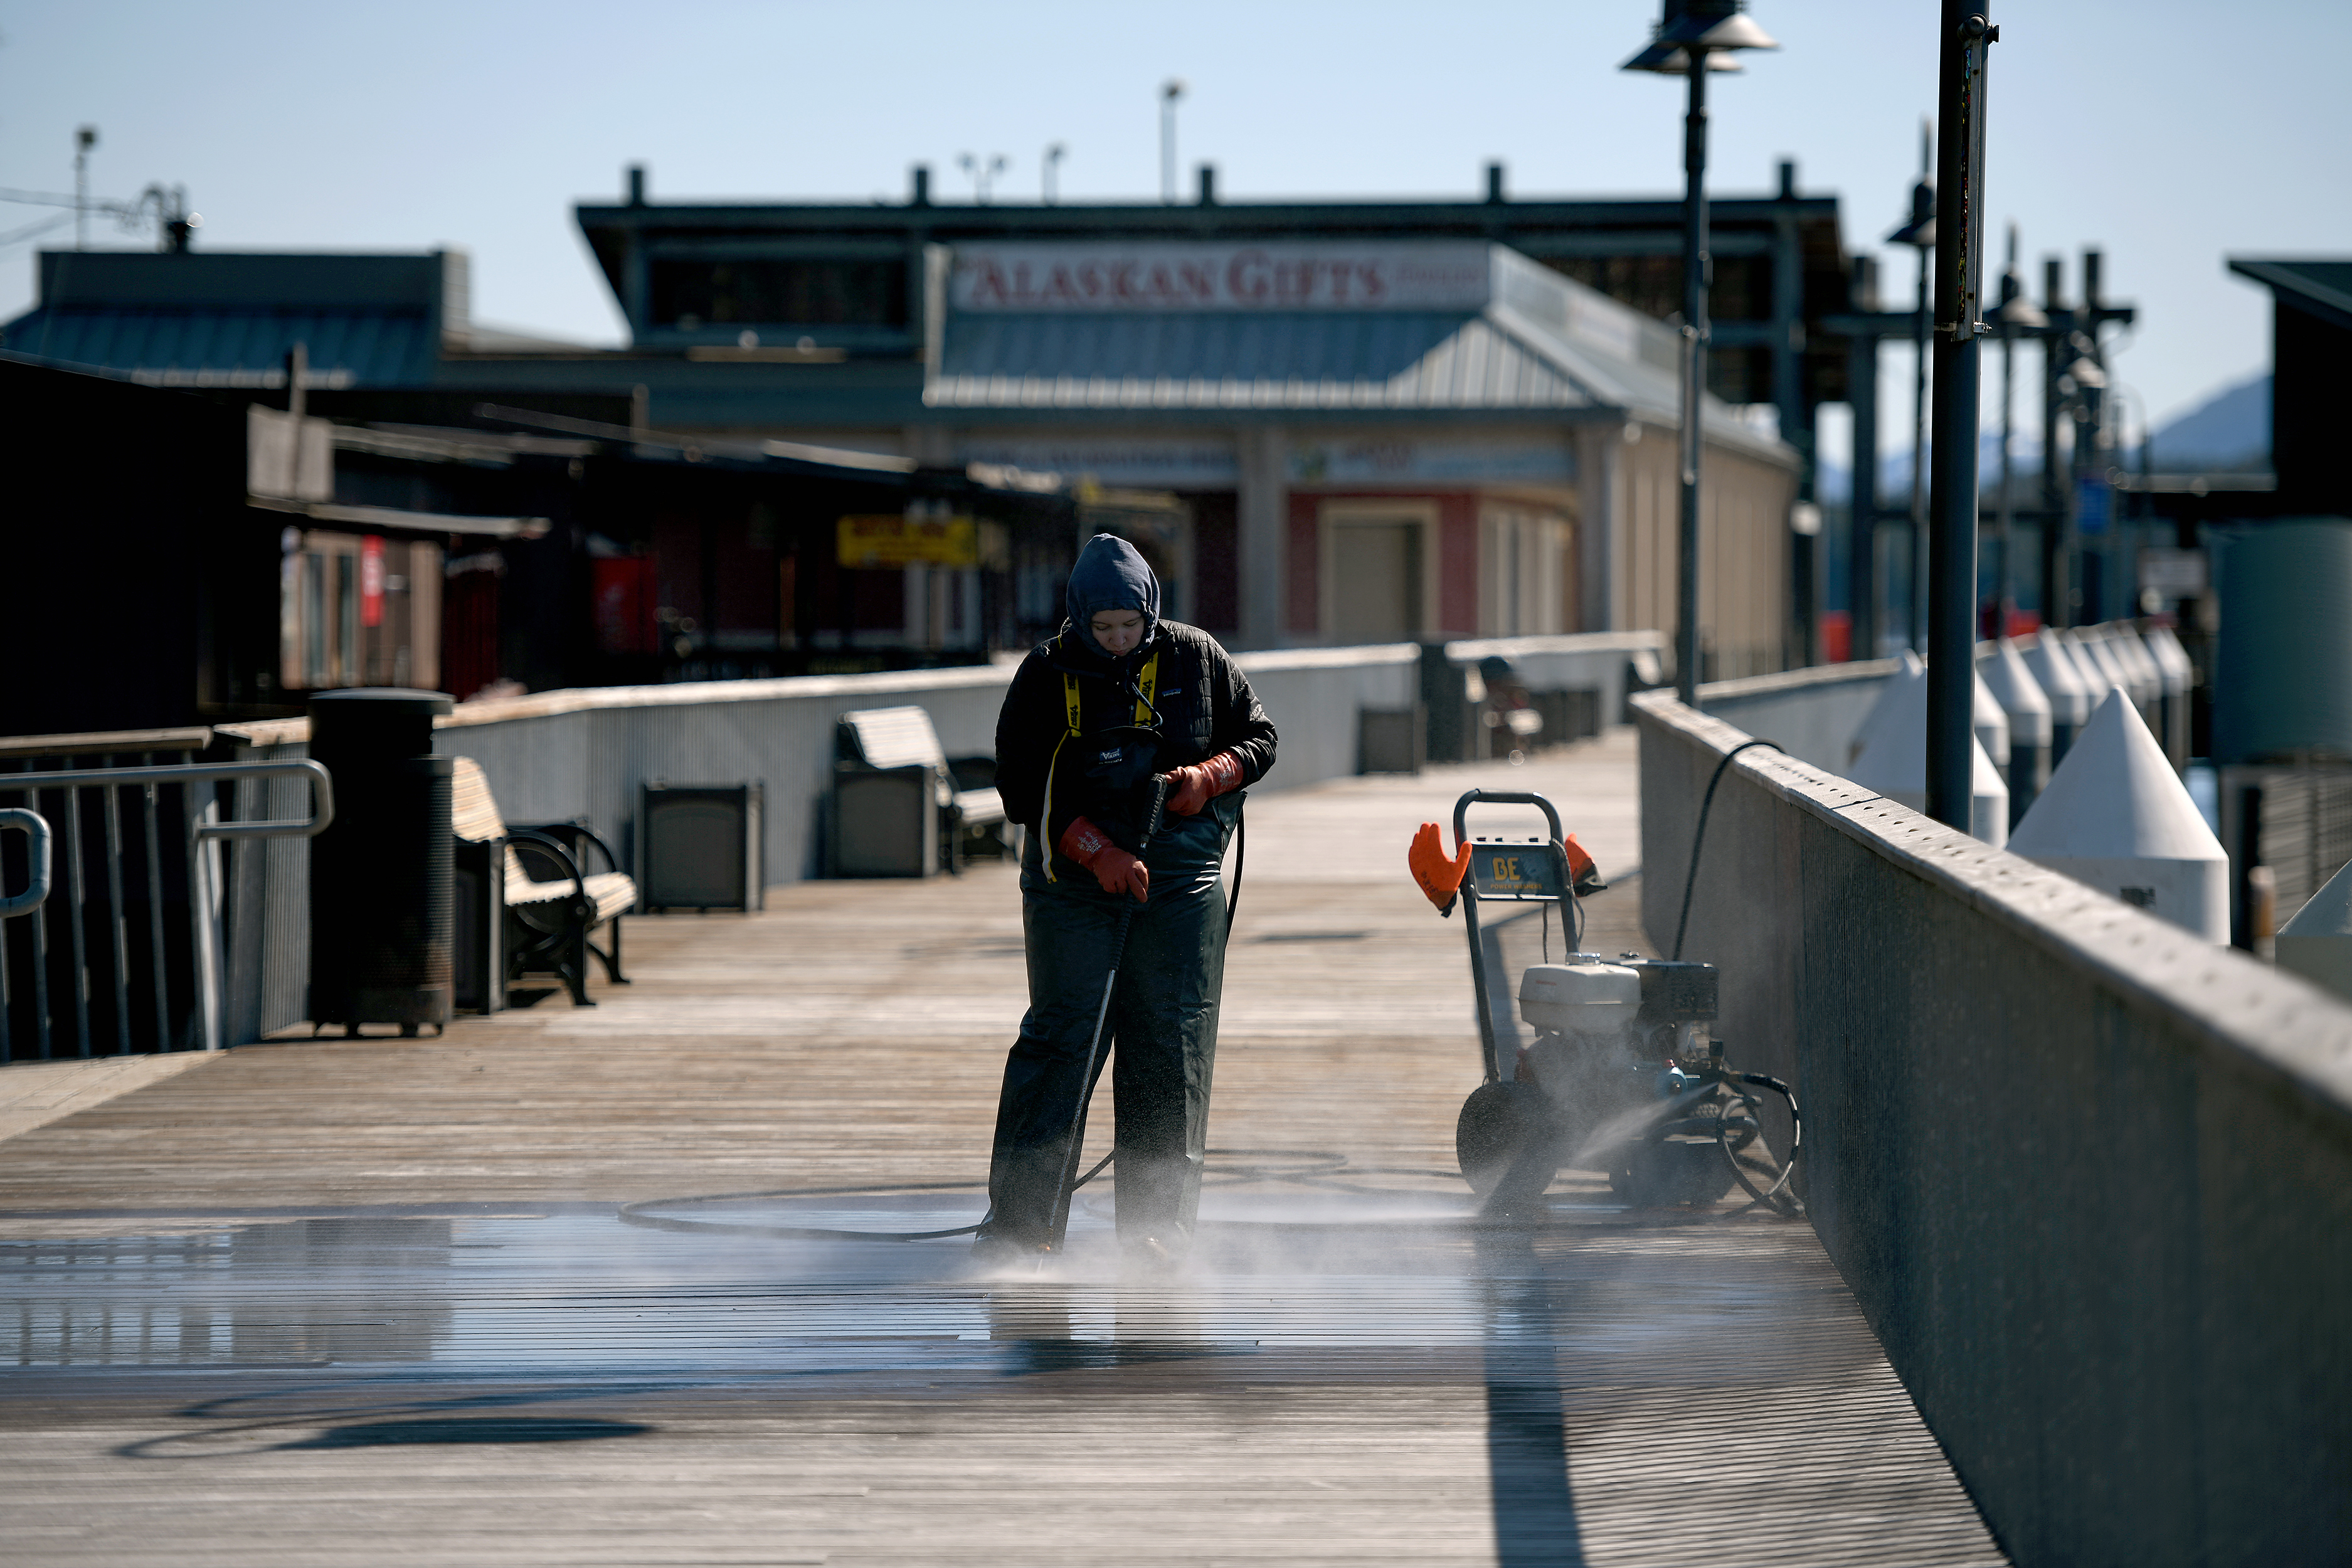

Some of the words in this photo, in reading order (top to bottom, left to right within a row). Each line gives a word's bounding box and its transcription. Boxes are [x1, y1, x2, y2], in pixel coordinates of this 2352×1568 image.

[971, 256, 1220, 305] ALASKAN
[1226, 250, 1388, 306] GIFTS
[1101, 751, 1120, 760] VIKING
[1493, 857, 1520, 881] BE
